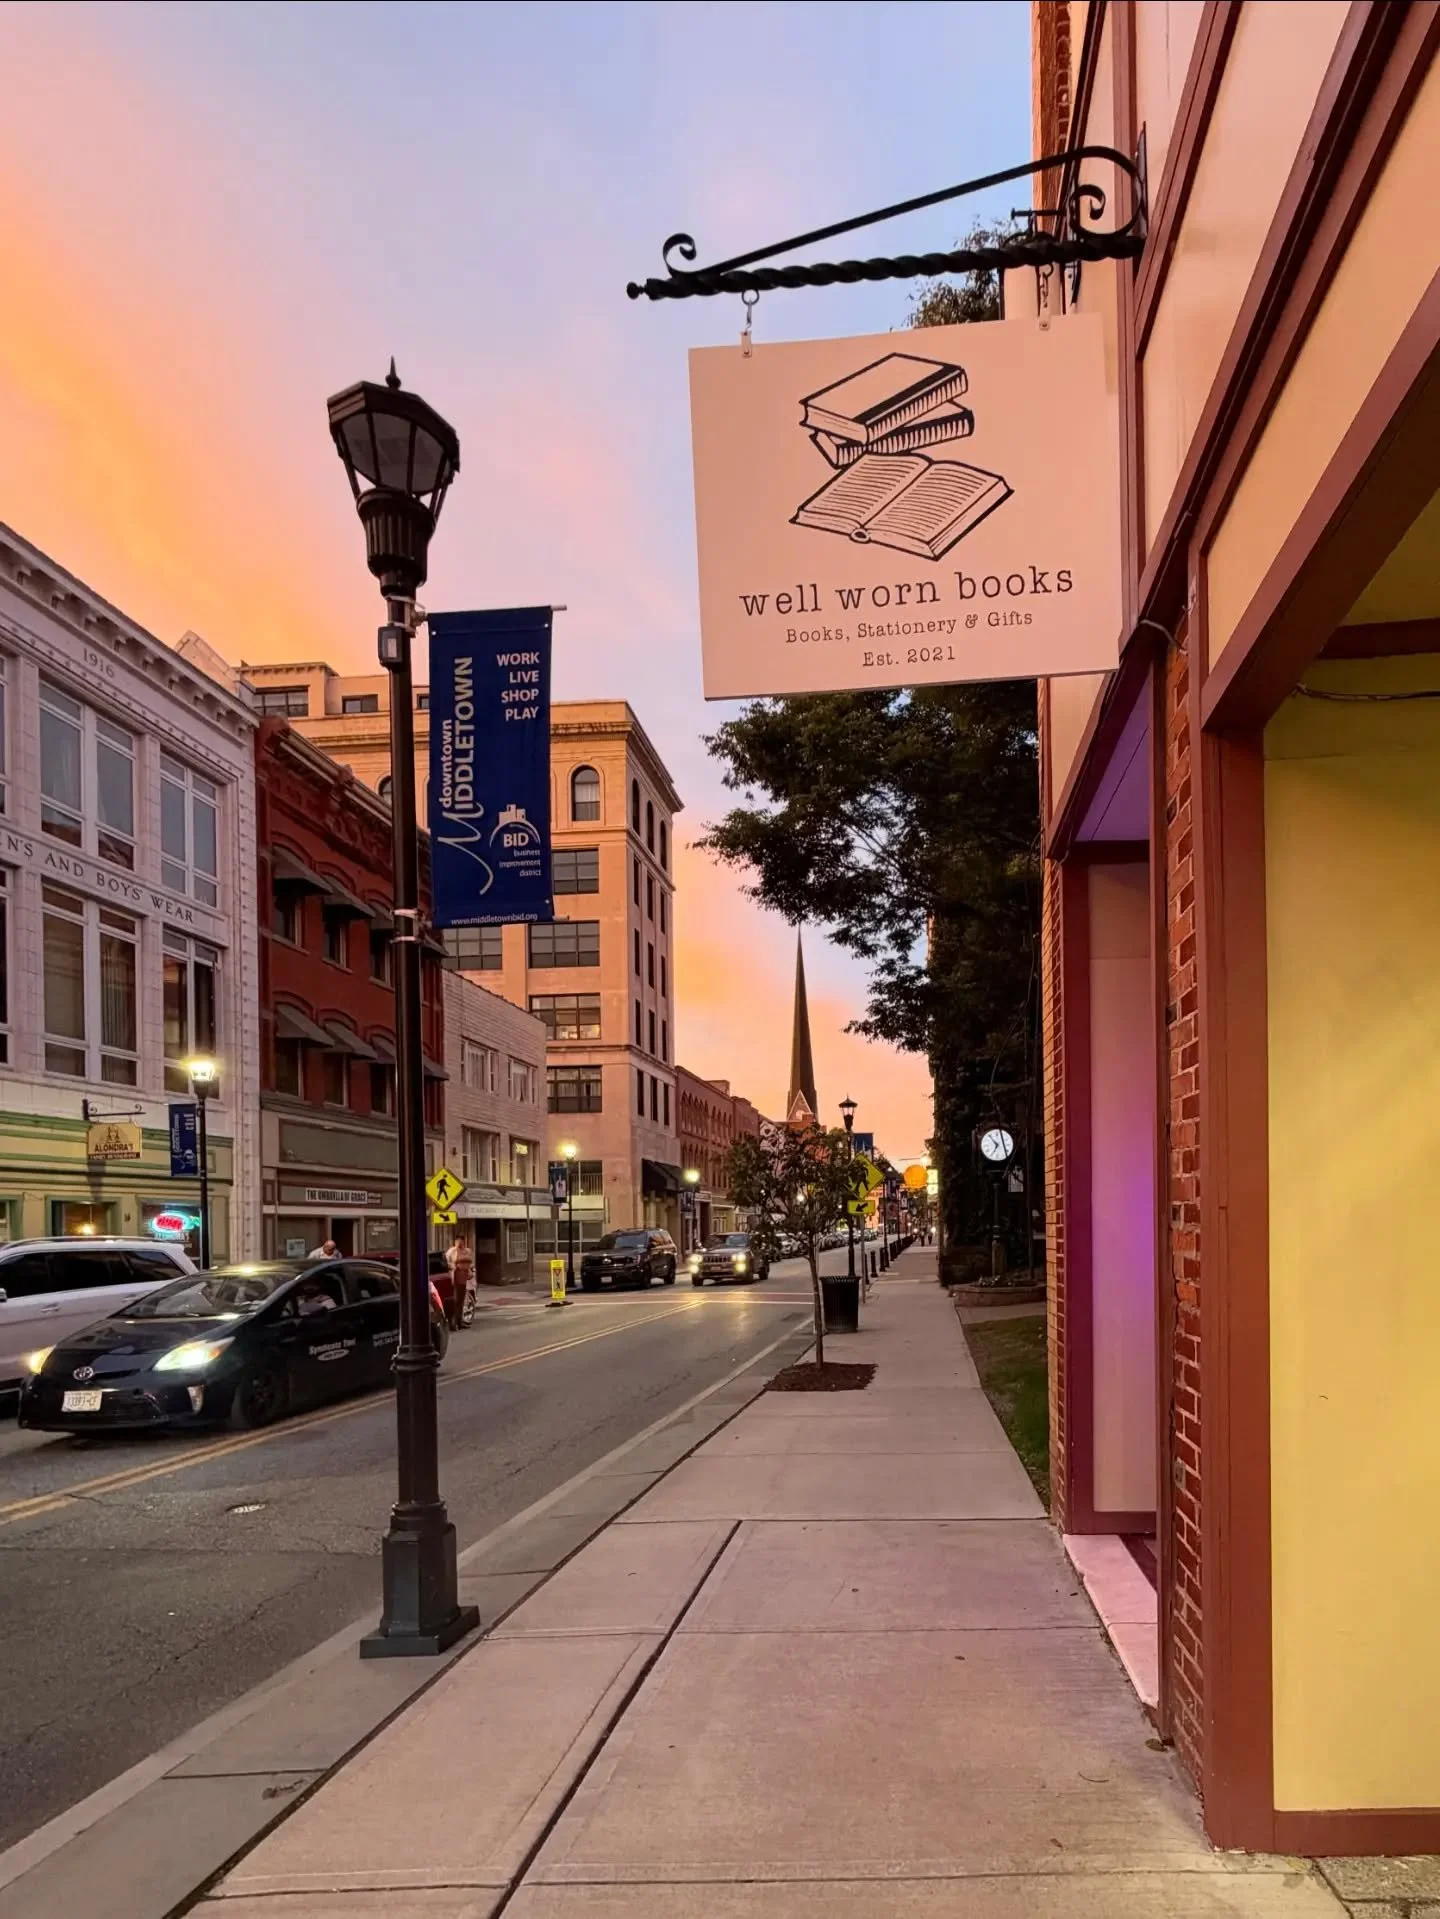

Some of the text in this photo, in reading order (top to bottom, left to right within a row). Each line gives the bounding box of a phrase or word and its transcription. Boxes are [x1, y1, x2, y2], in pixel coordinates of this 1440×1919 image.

[739, 565, 1073, 617] well worn books
[785, 610, 1033, 643] Books, Stationery & Gifts
[84, 647, 114, 678] 1916
[496, 652, 540, 666] WORK
[862, 645, 956, 667] Est. 2021
[509, 670, 540, 684] LIVE
[501, 688, 539, 703] SHOP
[505, 706, 539, 721] PLAY
[438, 719, 453, 808] downtown
[503, 832, 529, 848] BID
[45, 852, 84, 877] AND
[151, 894, 193, 923] WEAR
